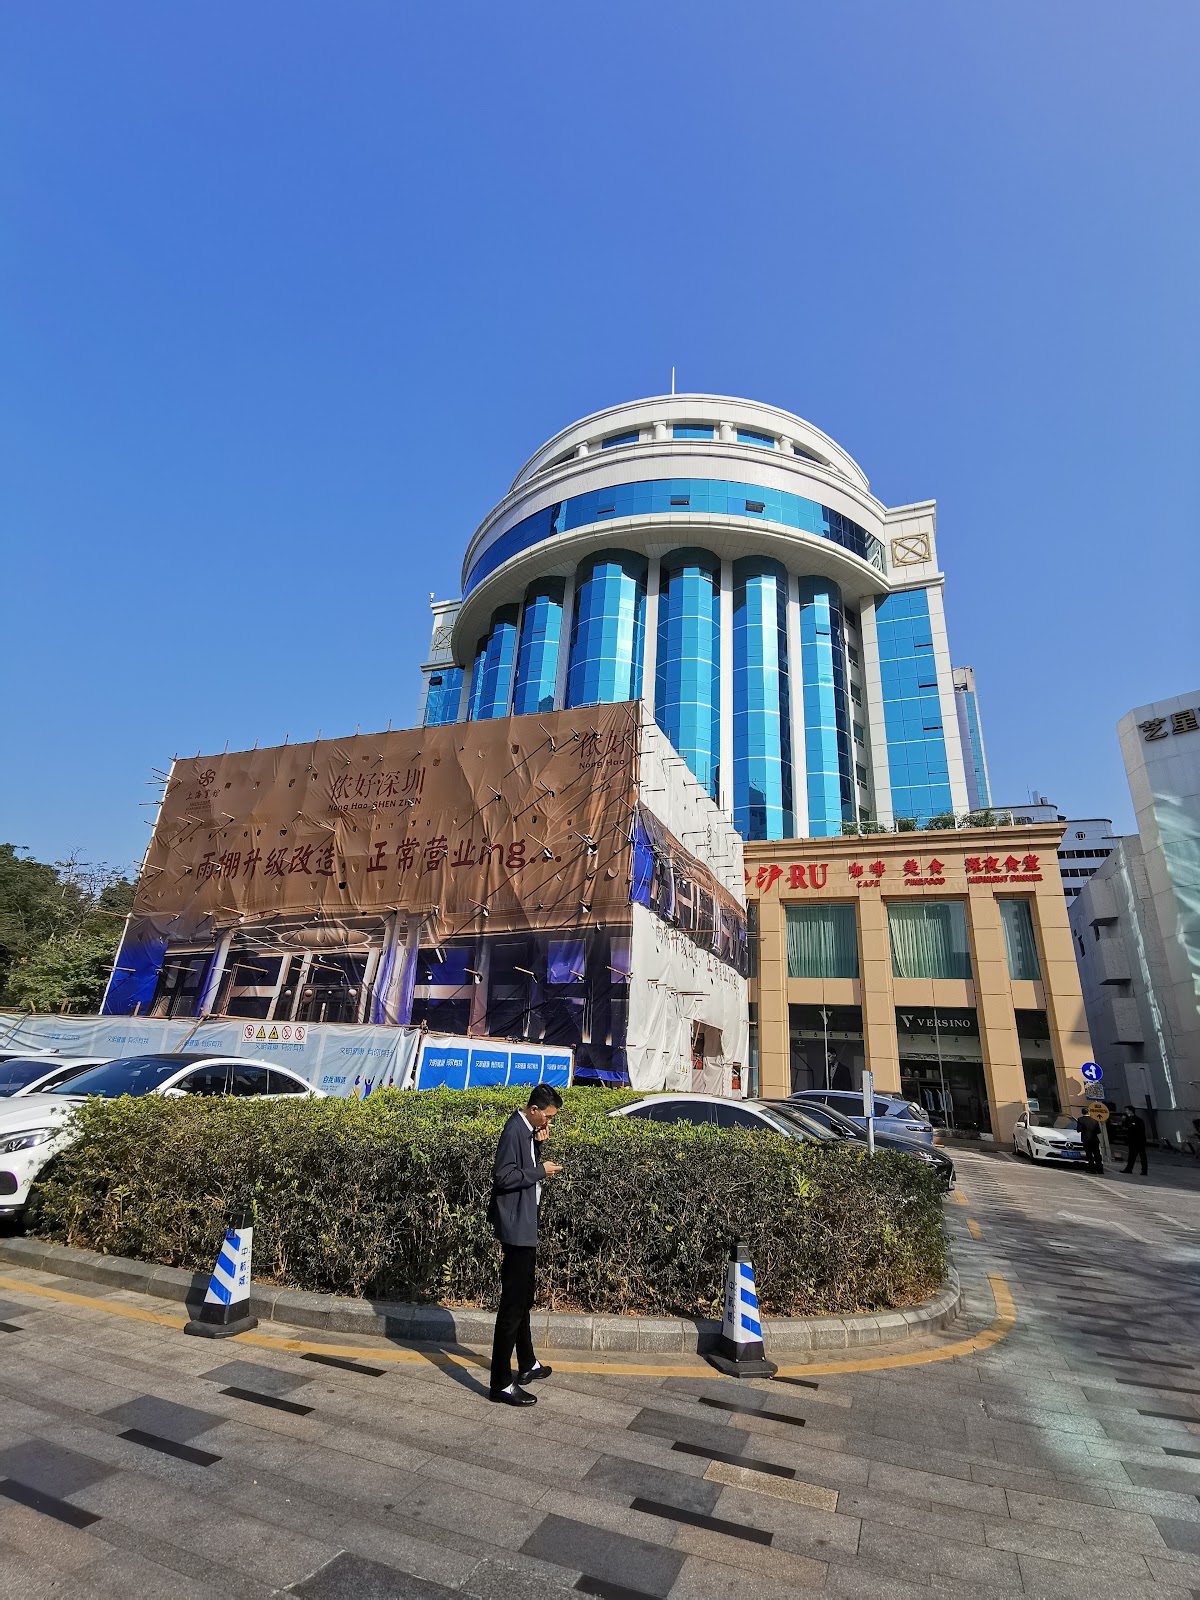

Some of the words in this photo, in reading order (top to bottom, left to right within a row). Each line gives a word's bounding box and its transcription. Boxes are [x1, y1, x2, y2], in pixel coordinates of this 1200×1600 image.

[1138, 708, 1200, 741] 艺星
[606, 759, 625, 767] Hao
[330, 767, 426, 801] 侬好深圳
[328, 804, 349, 812] Nong
[351, 802, 368, 810] Hao
[372, 800, 396, 809] SHEN
[848, 861, 886, 879] 咖啡
[902, 858, 945, 877] 美食
[965, 854, 1041, 874] 深夜食堂
[856, 880, 880, 888] CAFE
[967, 875, 1008, 884] MIDNIGHT
[1009, 873, 1043, 882] DINNER
[916, 1018, 971, 1028] VERSINO
